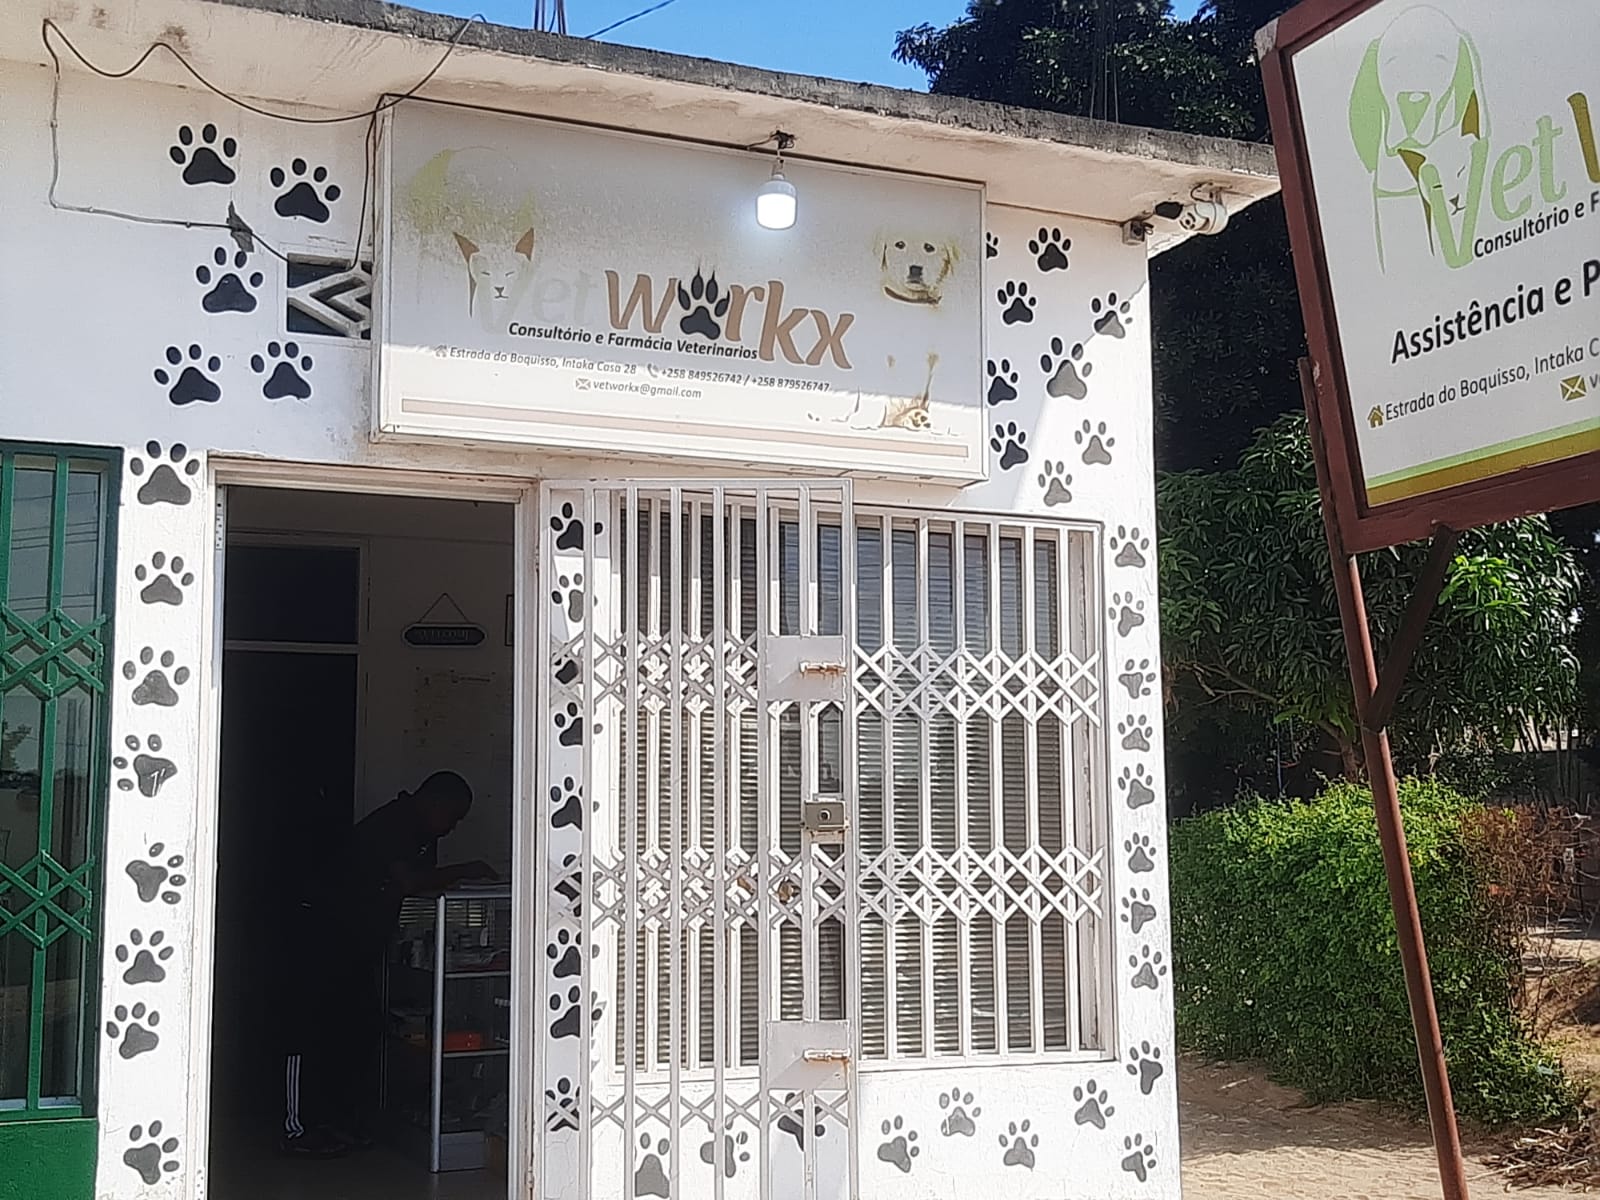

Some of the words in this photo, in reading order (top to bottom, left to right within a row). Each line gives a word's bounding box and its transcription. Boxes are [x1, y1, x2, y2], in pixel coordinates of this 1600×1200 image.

[1419, 115, 1567, 268] Vet
[1474, 207, 1569, 258] Consultório
[1574, 201, 1585, 218] e
[509, 322, 591, 343] Consultório
[595, 333, 604, 344] e
[607, 332, 672, 351] Farmácia
[677, 339, 758, 360] Veterinarios
[1391, 284, 1544, 364] Assistência
[1554, 277, 1572, 305] e
[450, 346, 490, 361] Estrada
[493, 350, 507, 362] do
[510, 353, 559, 369] Boquisso,
[562, 357, 594, 371] Intaka
[597, 361, 621, 374] Casa
[623, 364, 637, 375] 28
[661, 367, 685, 380] +258
[687, 370, 742, 384] 849526742
[743, 374, 750, 386] /
[752, 376, 775, 388] +258
[593, 380, 702, 399] vetworkx@gmail.com
[1386, 392, 1434, 420] Estrada
[1438, 385, 1456, 403] do
[1460, 365, 1530, 398] Boquisso,
[1534, 345, 1584, 374] Intaka
